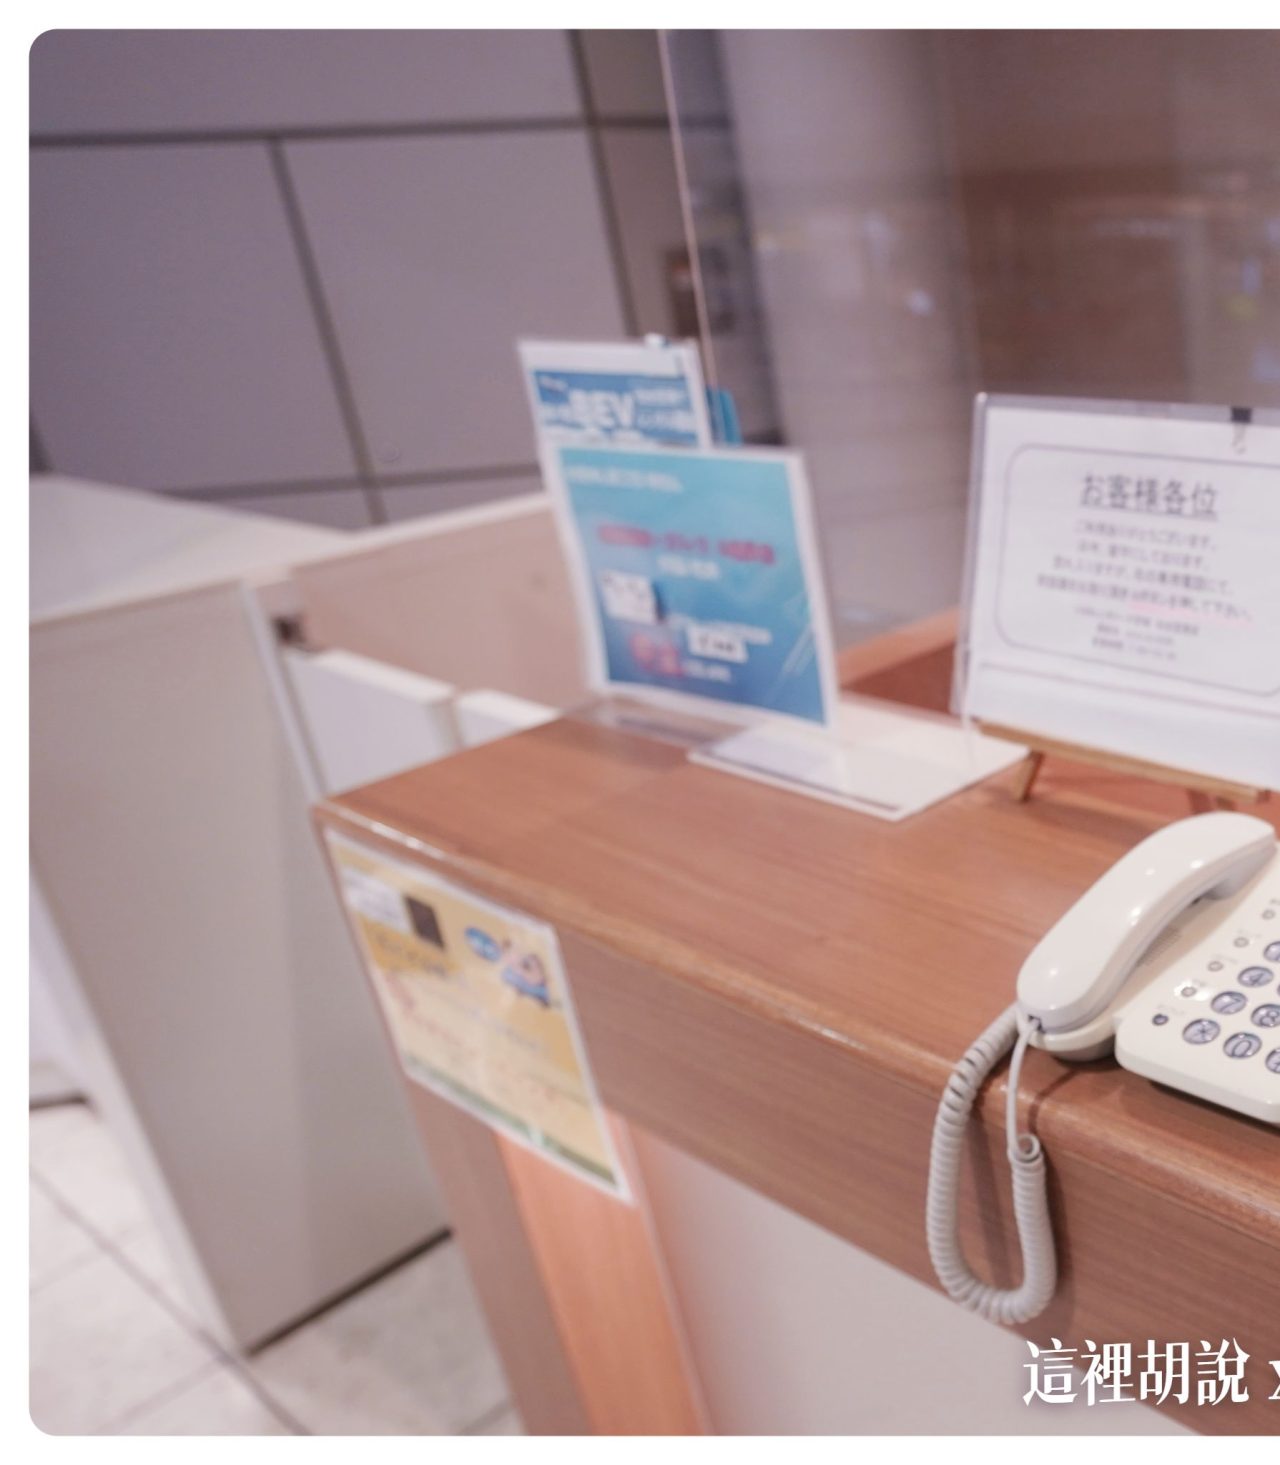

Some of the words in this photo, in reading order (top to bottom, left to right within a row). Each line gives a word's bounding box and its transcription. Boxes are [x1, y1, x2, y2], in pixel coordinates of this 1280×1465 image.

[1080, 472, 1219, 518] お客様各位
